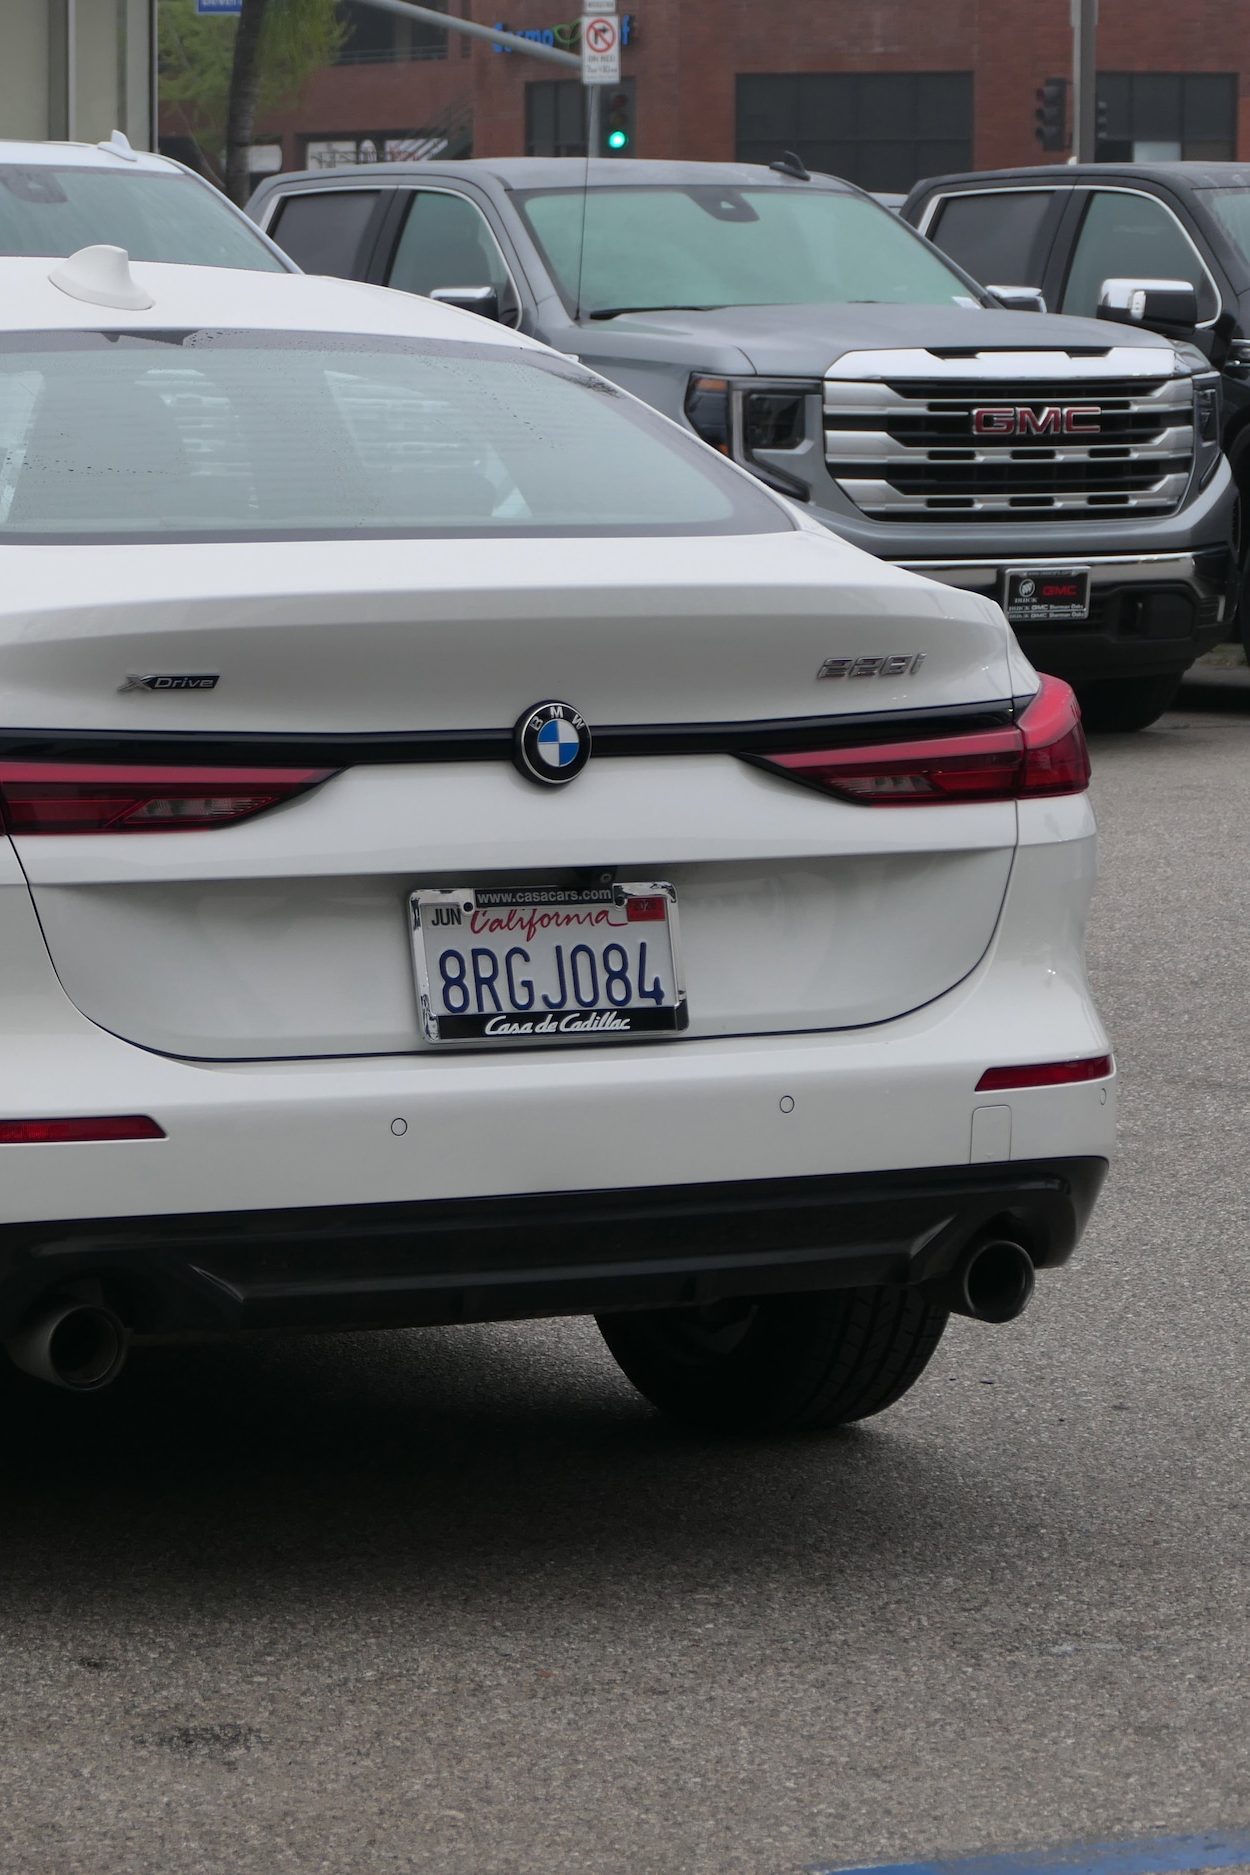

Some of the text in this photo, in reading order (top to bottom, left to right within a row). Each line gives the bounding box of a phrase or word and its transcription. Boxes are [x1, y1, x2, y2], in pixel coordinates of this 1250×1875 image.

[972, 406, 1101, 435] GMC
[1042, 585, 1078, 596] GMC
[816, 653, 928, 679] 228i
[529, 706, 585, 731] BMW
[477, 888, 612, 904] www.casacars.com
[432, 908, 462, 926] JUN
[470, 908, 628, 942] California
[439, 941, 665, 1014] 8RGJ084
[485, 1011, 631, 1035] Casa de Cadillac
